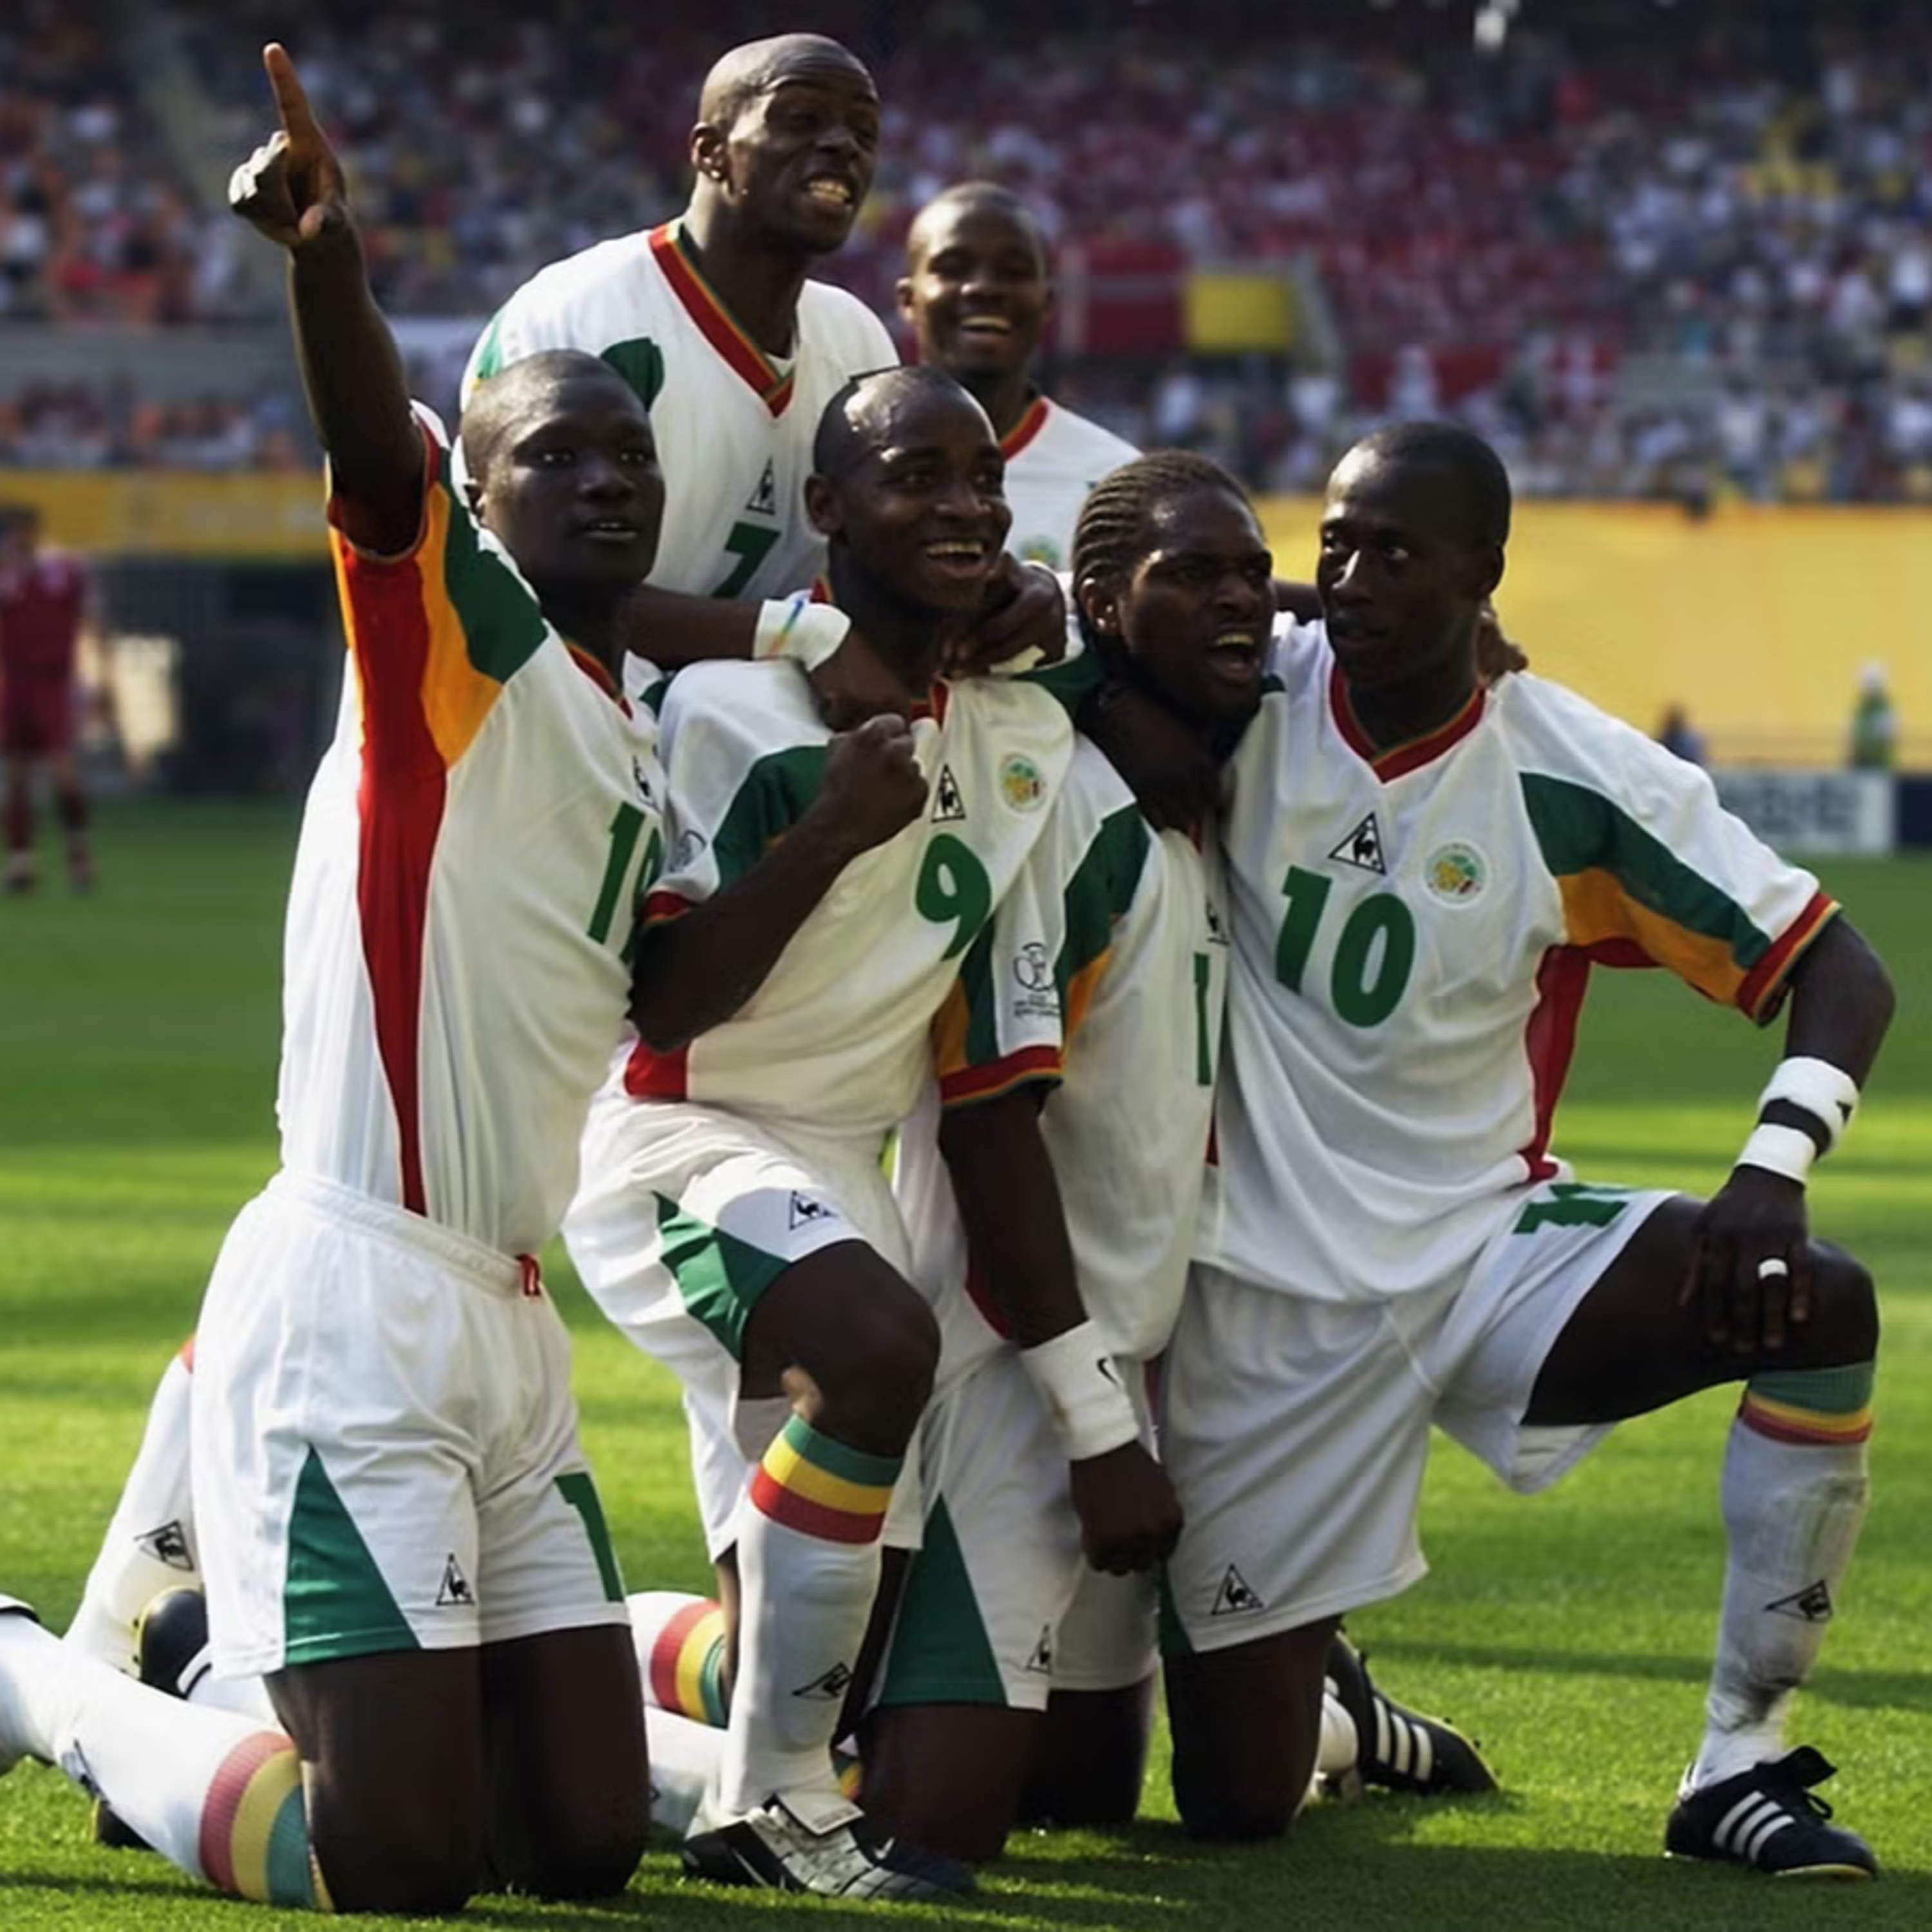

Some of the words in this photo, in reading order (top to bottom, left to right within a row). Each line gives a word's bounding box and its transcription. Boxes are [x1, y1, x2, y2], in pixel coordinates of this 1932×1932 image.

[714, 521, 781, 598] 7
[915, 833, 992, 963] 9
[1274, 866, 1417, 1028] 10
